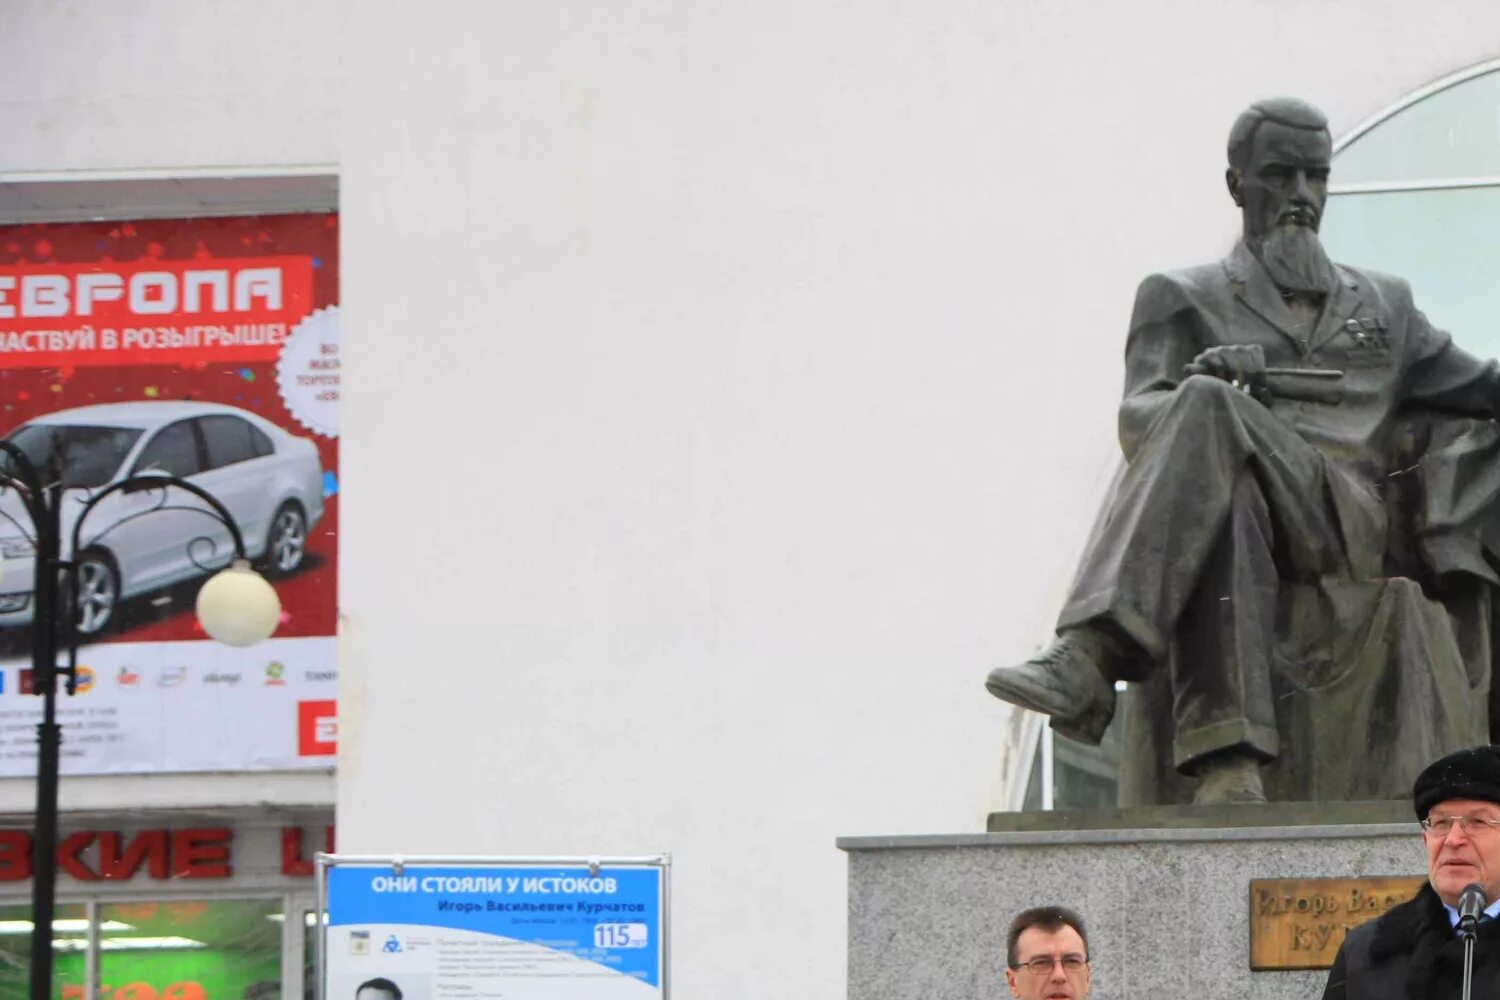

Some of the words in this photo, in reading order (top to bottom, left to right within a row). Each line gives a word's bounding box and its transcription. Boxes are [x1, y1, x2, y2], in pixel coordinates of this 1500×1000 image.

[101, 328, 119, 350] В
[371, 876, 417, 893] ОНИ
[421, 876, 503, 893] СТОЯЛИ
[505, 877, 520, 894] У
[523, 877, 618, 894] ИСТОКОВ
[438, 901, 483, 915] Игорь
[486, 900, 574, 914] Васильевич
[577, 901, 645, 915] Курчатов
[596, 926, 630, 946] 115
